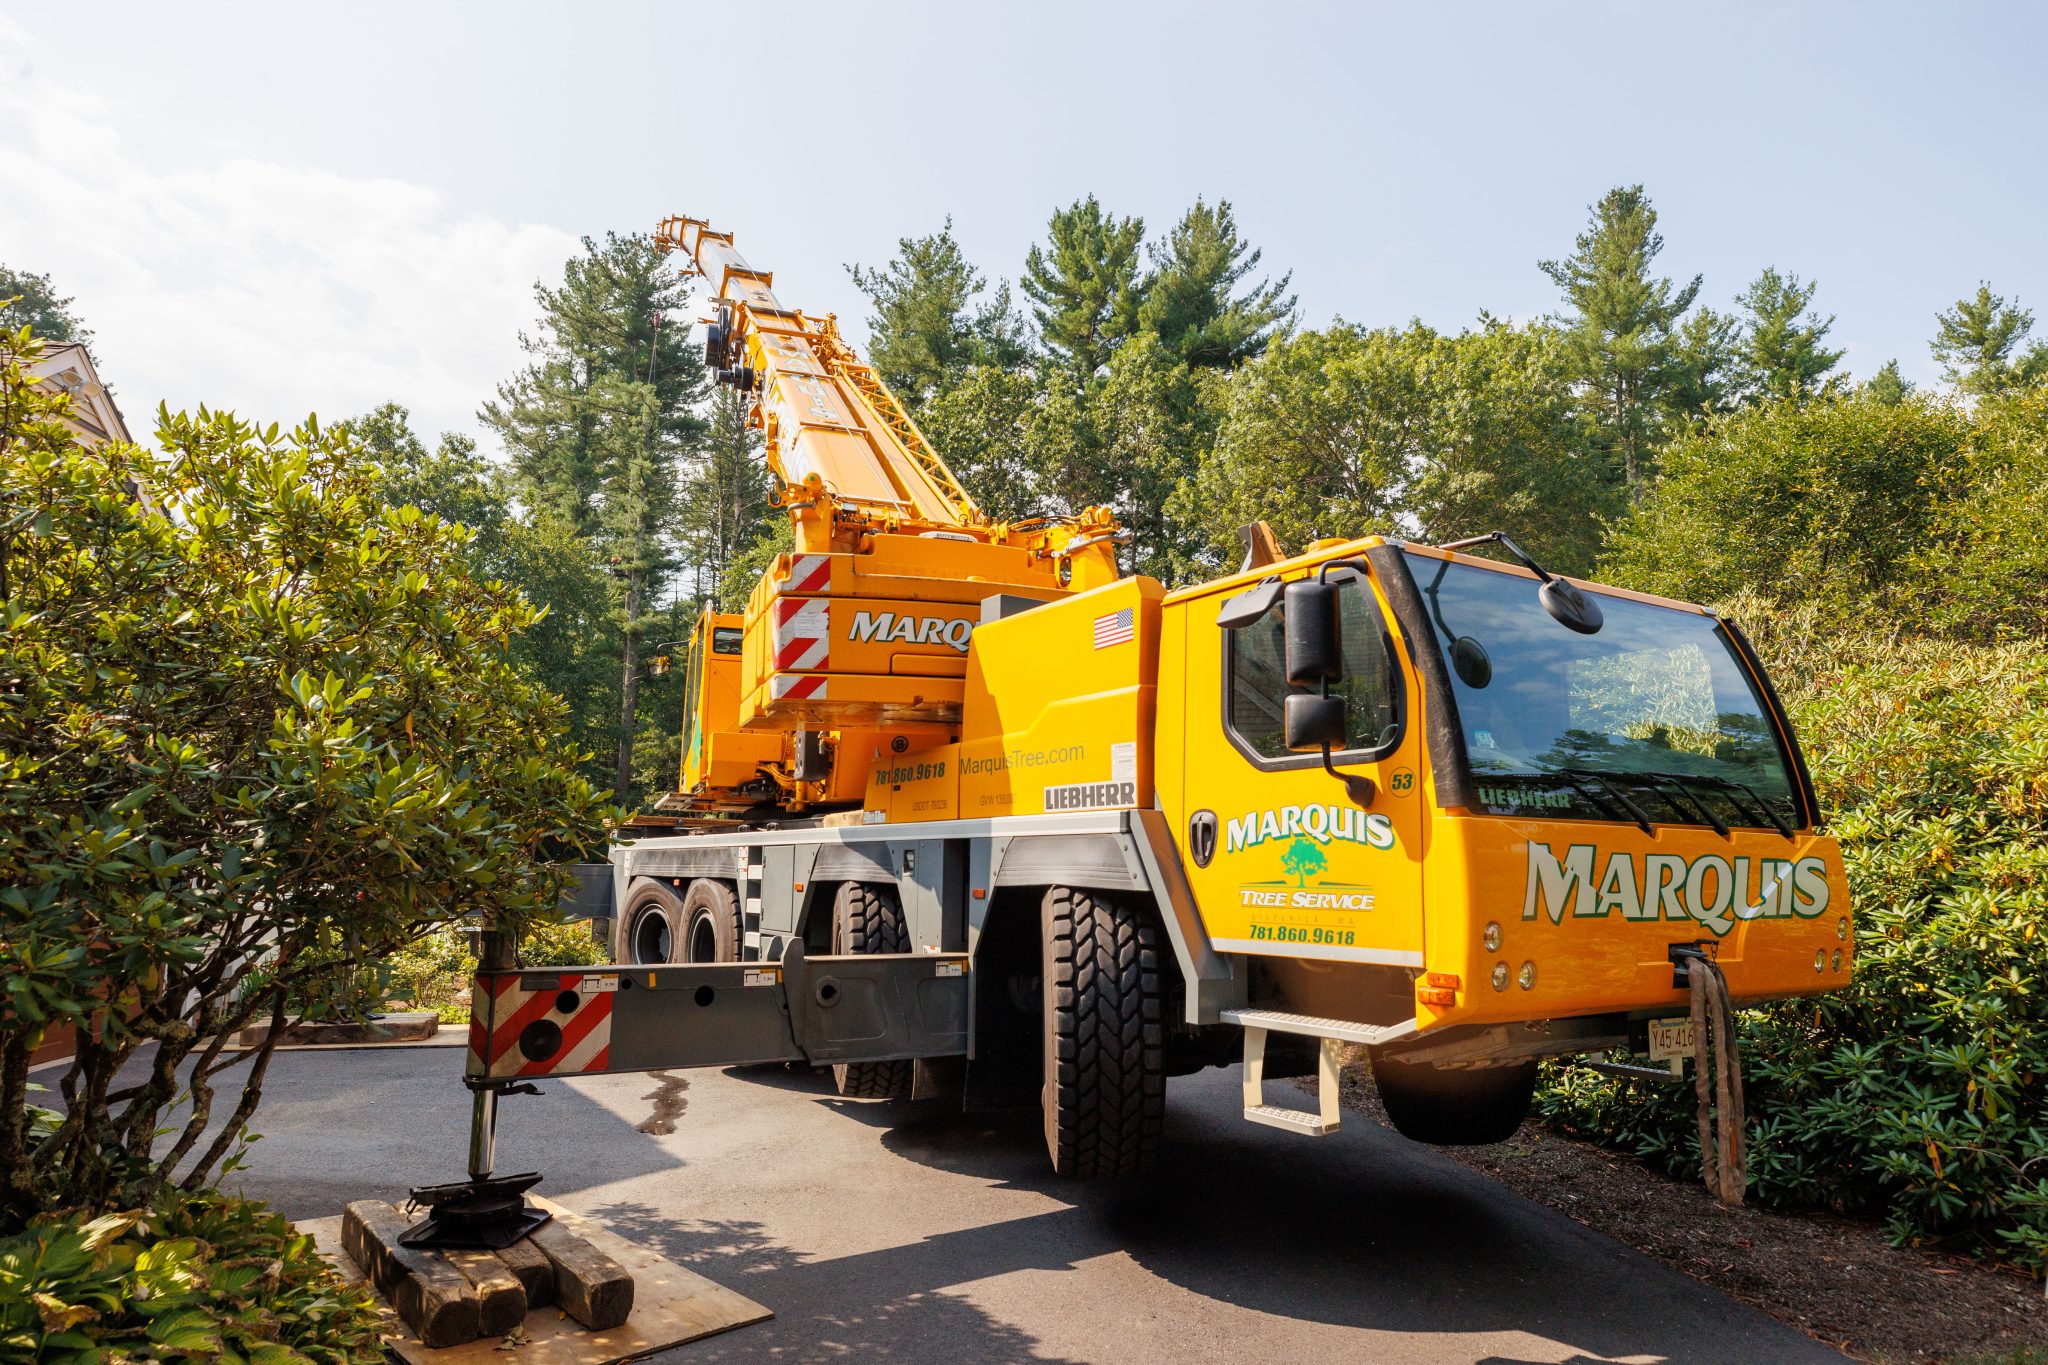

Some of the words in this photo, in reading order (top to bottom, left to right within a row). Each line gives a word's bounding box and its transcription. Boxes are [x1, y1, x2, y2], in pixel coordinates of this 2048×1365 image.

[848, 611, 981, 653] MARQ
[875, 762, 946, 785] 781.860.9618
[960, 745, 1085, 776] MarquisTree.com
[1045, 782, 1135, 809] LIEBHERR
[1391, 774, 1413, 790] 53
[1227, 803, 1395, 853] MARQUIS
[1239, 890, 1287, 907] TREE
[1290, 891, 1376, 910] SERVICE
[1521, 840, 1830, 937] MARQUIS
[1250, 924, 1355, 945] 781.860.9618
